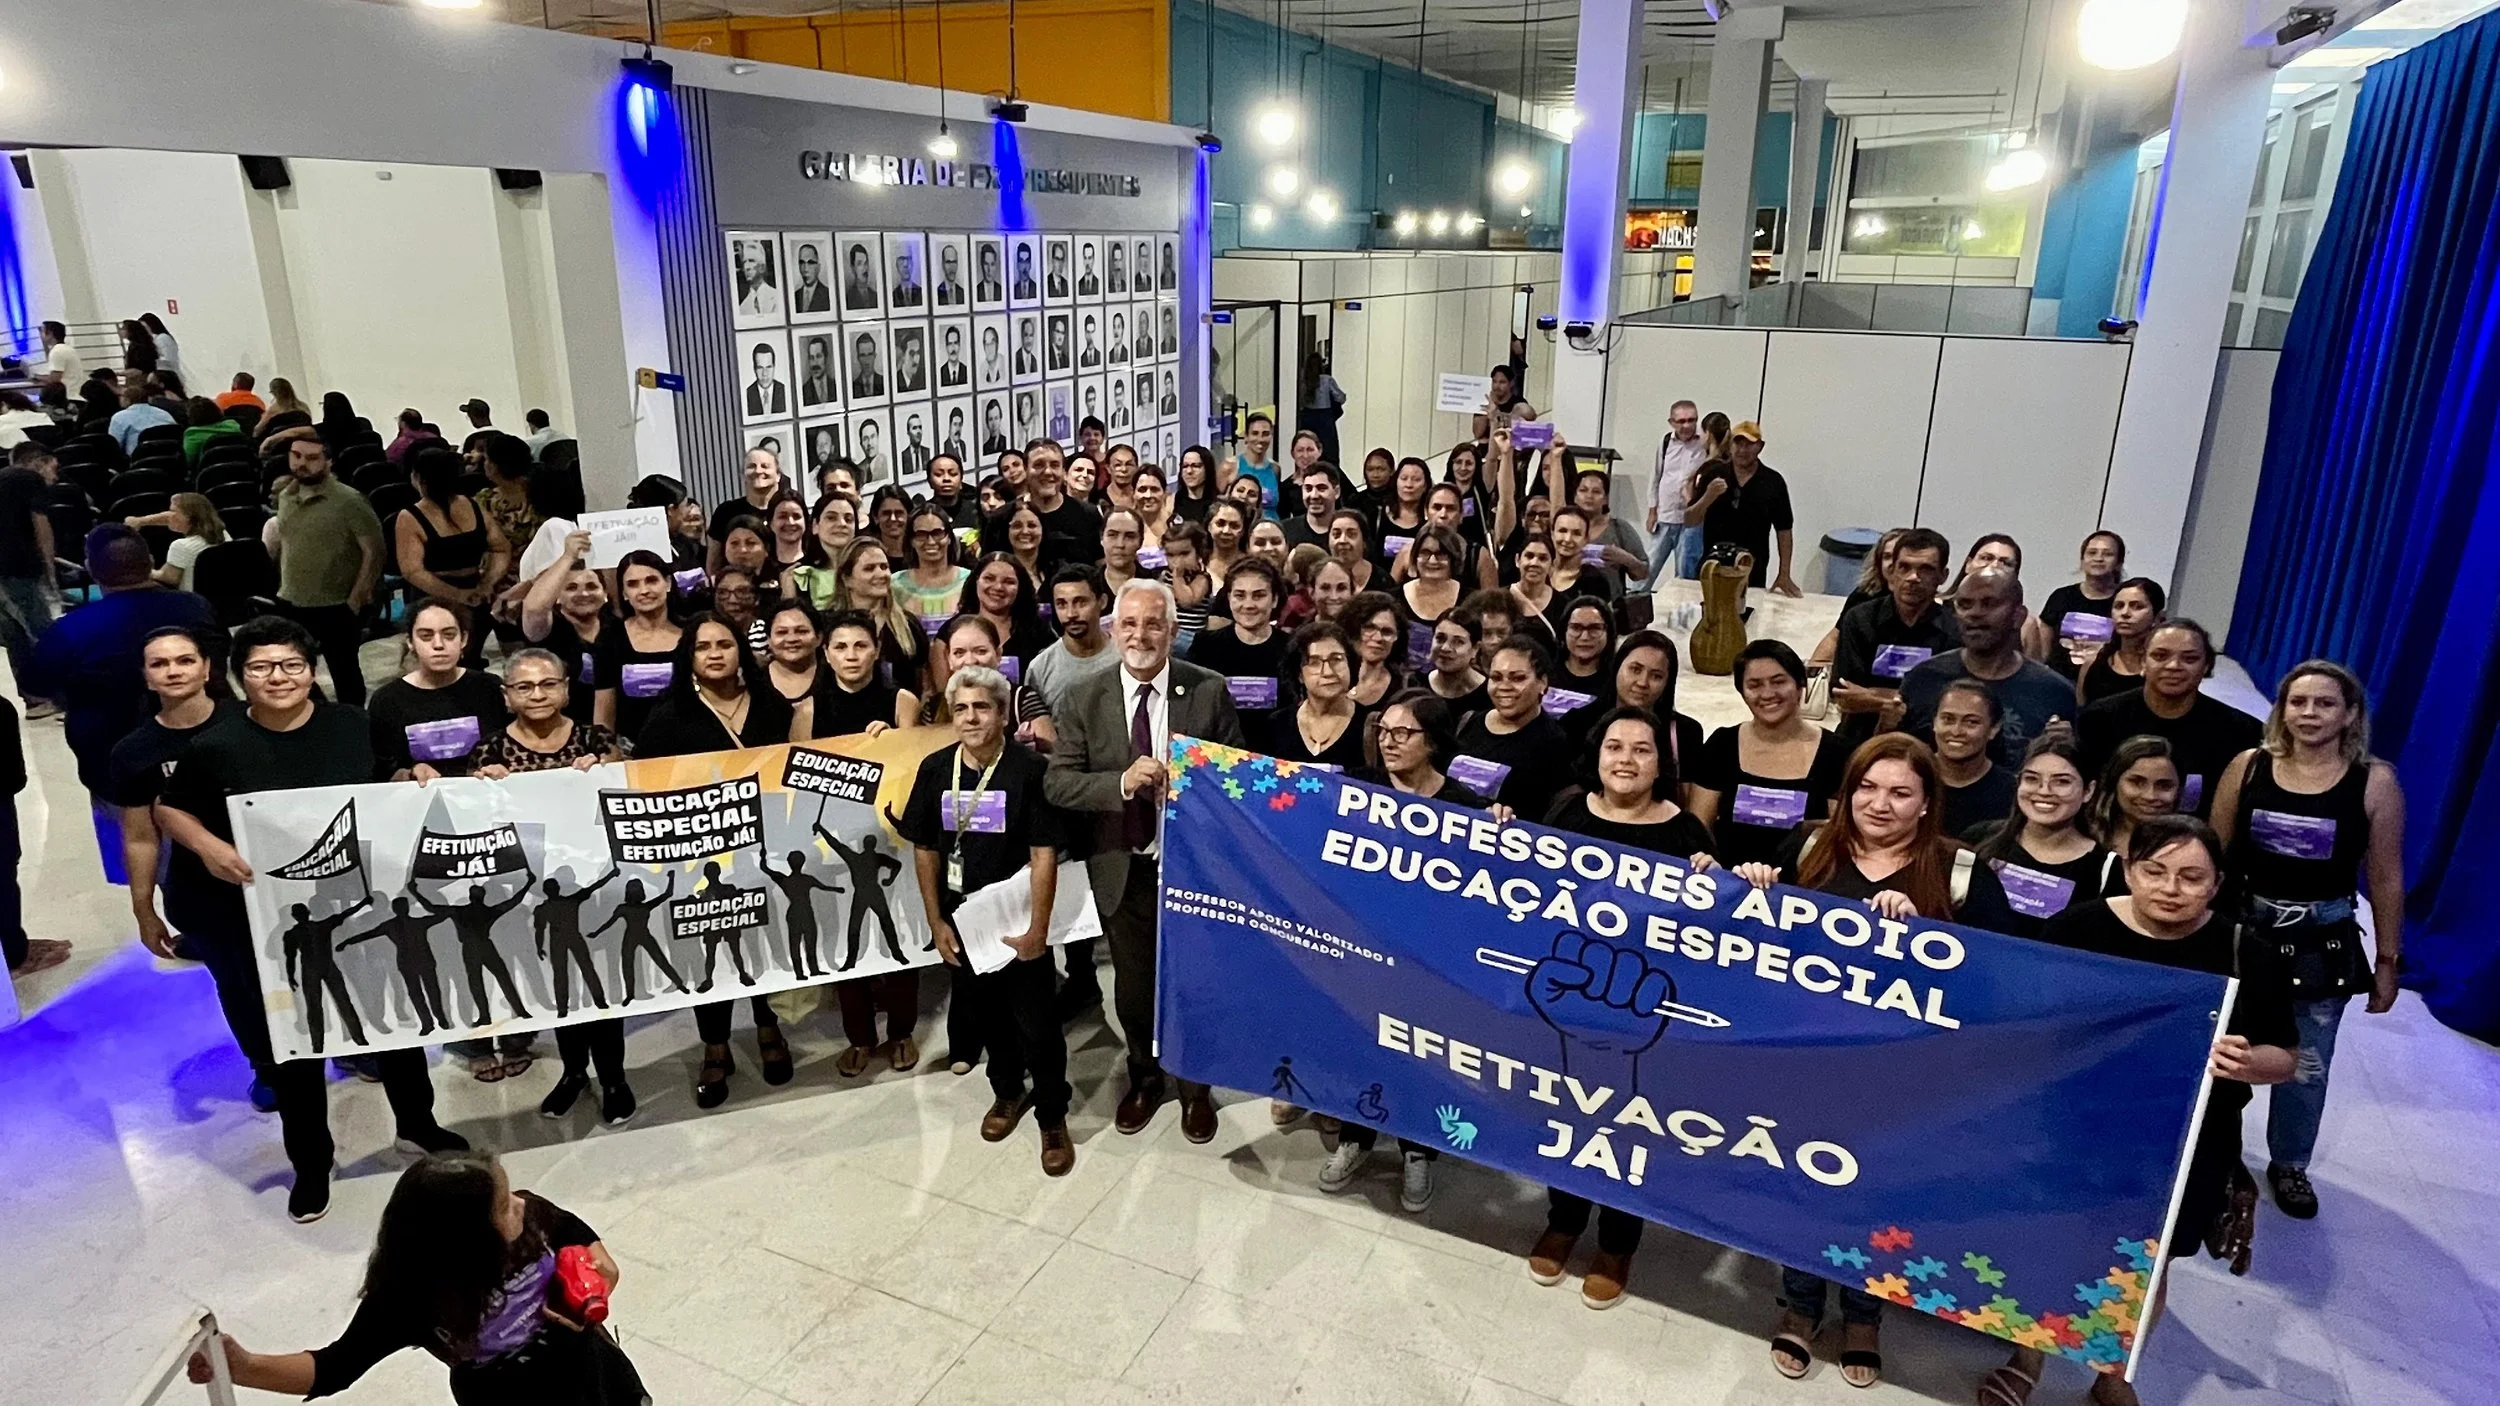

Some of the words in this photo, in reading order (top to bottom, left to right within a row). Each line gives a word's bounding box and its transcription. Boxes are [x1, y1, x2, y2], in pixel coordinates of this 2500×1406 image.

[792, 752, 880, 783] EDUCAÇÃO
[606, 781, 758, 816] EDUCAÇÃO
[787, 771, 865, 801] ESPECIAL
[284, 807, 352, 873] EDUCAÇÃO
[614, 805, 758, 840] ESPECIAL
[421, 829, 517, 856] EFETIVAÇÃO
[622, 835, 725, 861] EFETIVAÇÃO
[728, 826, 757, 848] JÁ!
[286, 848, 352, 879] ESPECIAL
[446, 855, 497, 877] JÁ!
[1337, 784, 1717, 910] PROFESSORES
[1732, 888, 1966, 970] APOIO
[673, 892, 766, 919] EDUCAÇÃO
[677, 911, 759, 936] ESPECIAL
[1165, 900, 1245, 926] PROFESSOR
[1249, 919, 1345, 960] CONCURSADO!
[1166, 887, 1246, 913] PROFESSOR
[1249, 908, 1292, 930] APOIO
[1296, 923, 1384, 963] VALORIZADO
[1321, 829, 1629, 938] EDUCAÇÃO
[1645, 914, 1961, 1031] ESPECIAL
[1377, 1012, 1859, 1187] EFETIVAÇÃO
[1537, 1119, 1649, 1187] JÁ!
